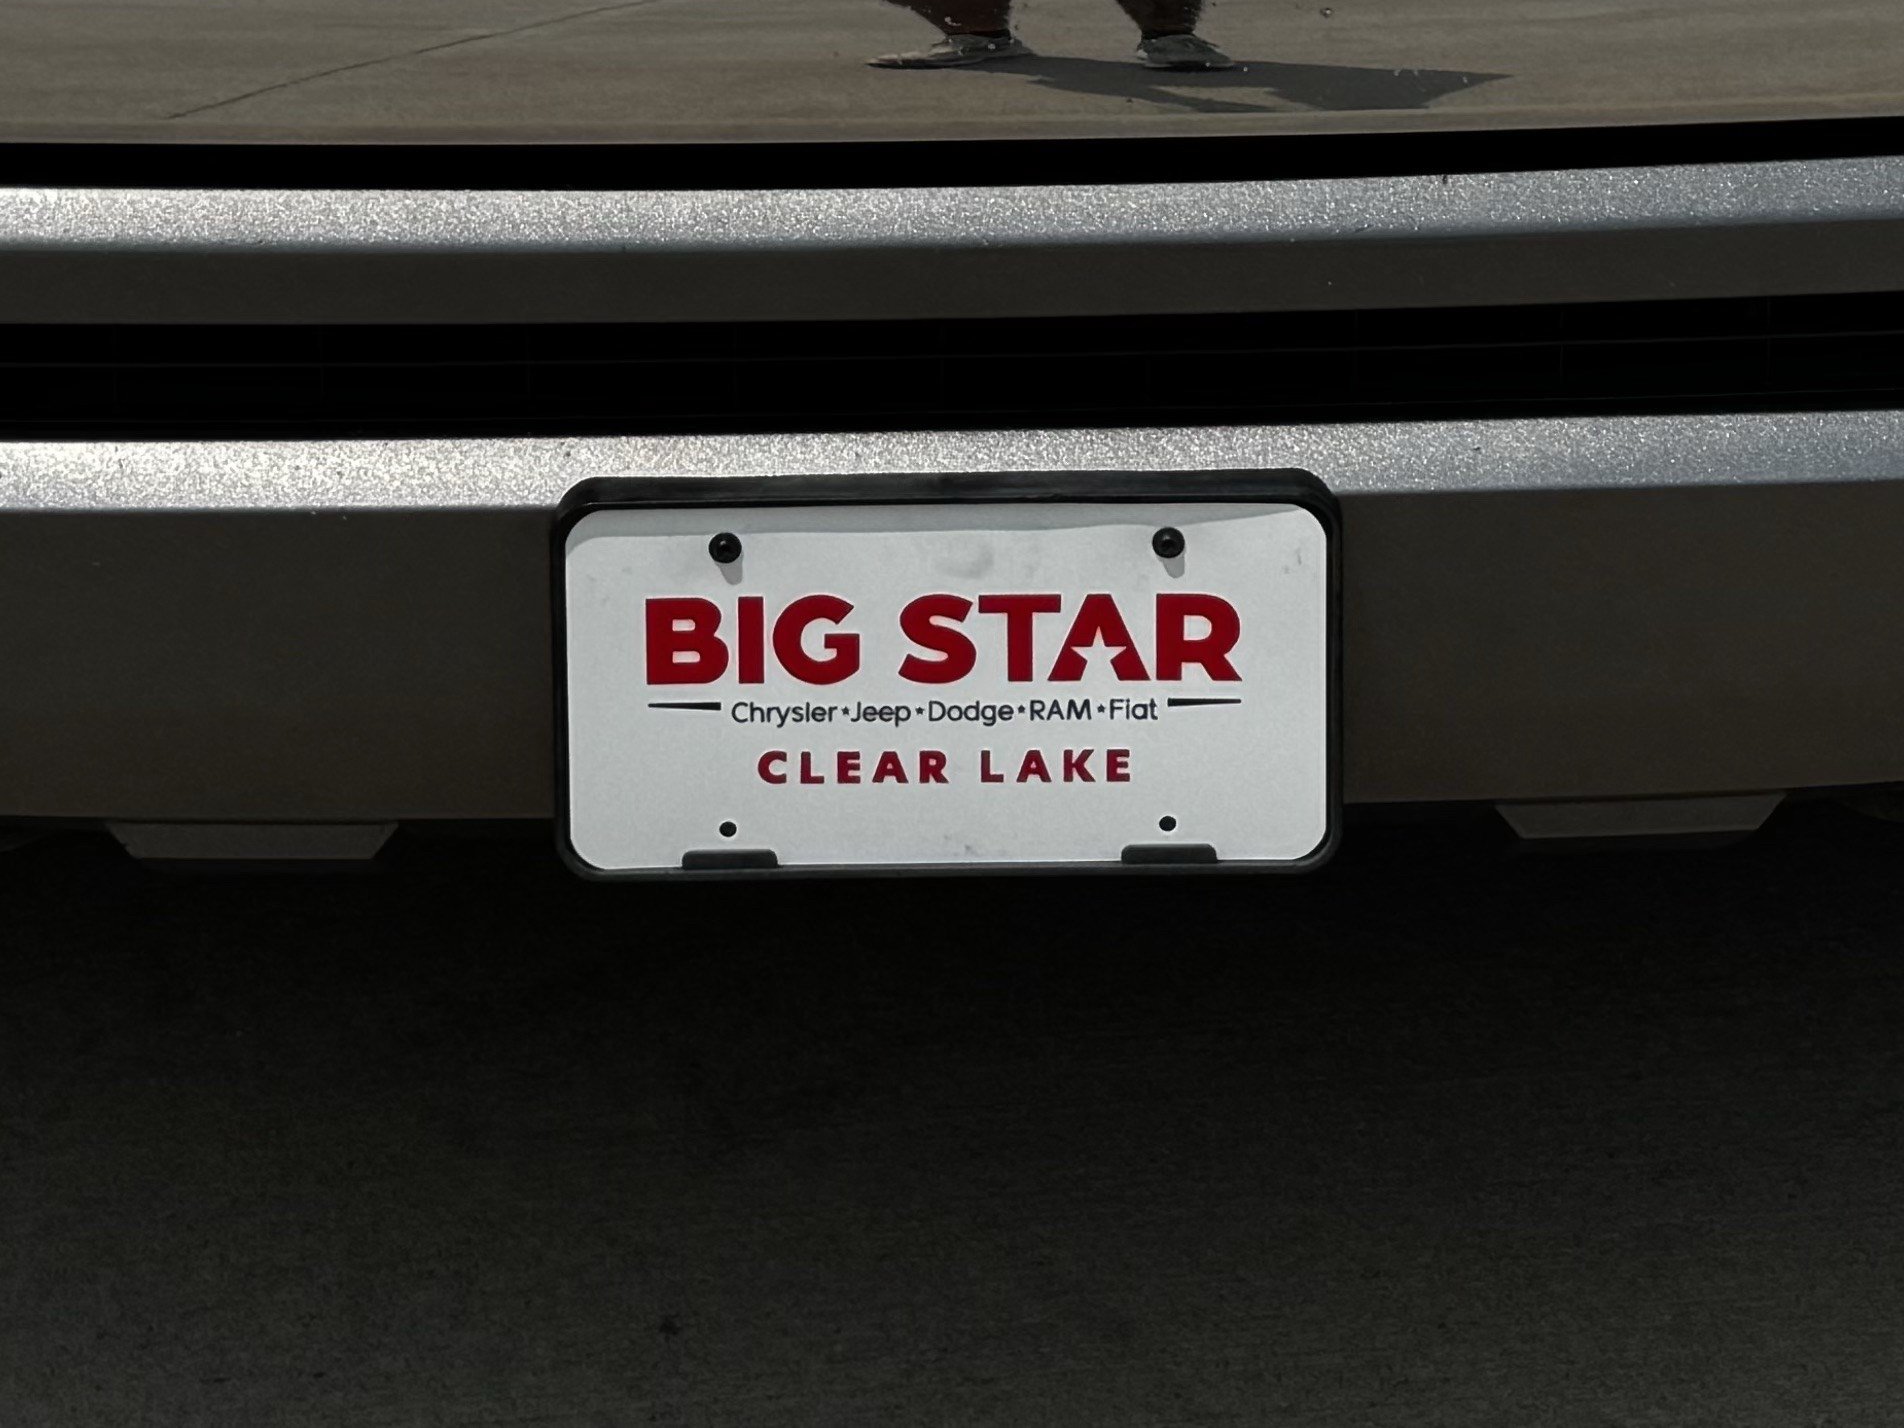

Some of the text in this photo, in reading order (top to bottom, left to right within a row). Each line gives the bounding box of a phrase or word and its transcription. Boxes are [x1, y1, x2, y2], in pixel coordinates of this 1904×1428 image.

[645, 593, 1243, 685] BIG STAR
[730, 697, 1159, 729] Chrysler Jeep Dodge RAM Fiat
[757, 748, 1133, 786] CLEAR LAKE
